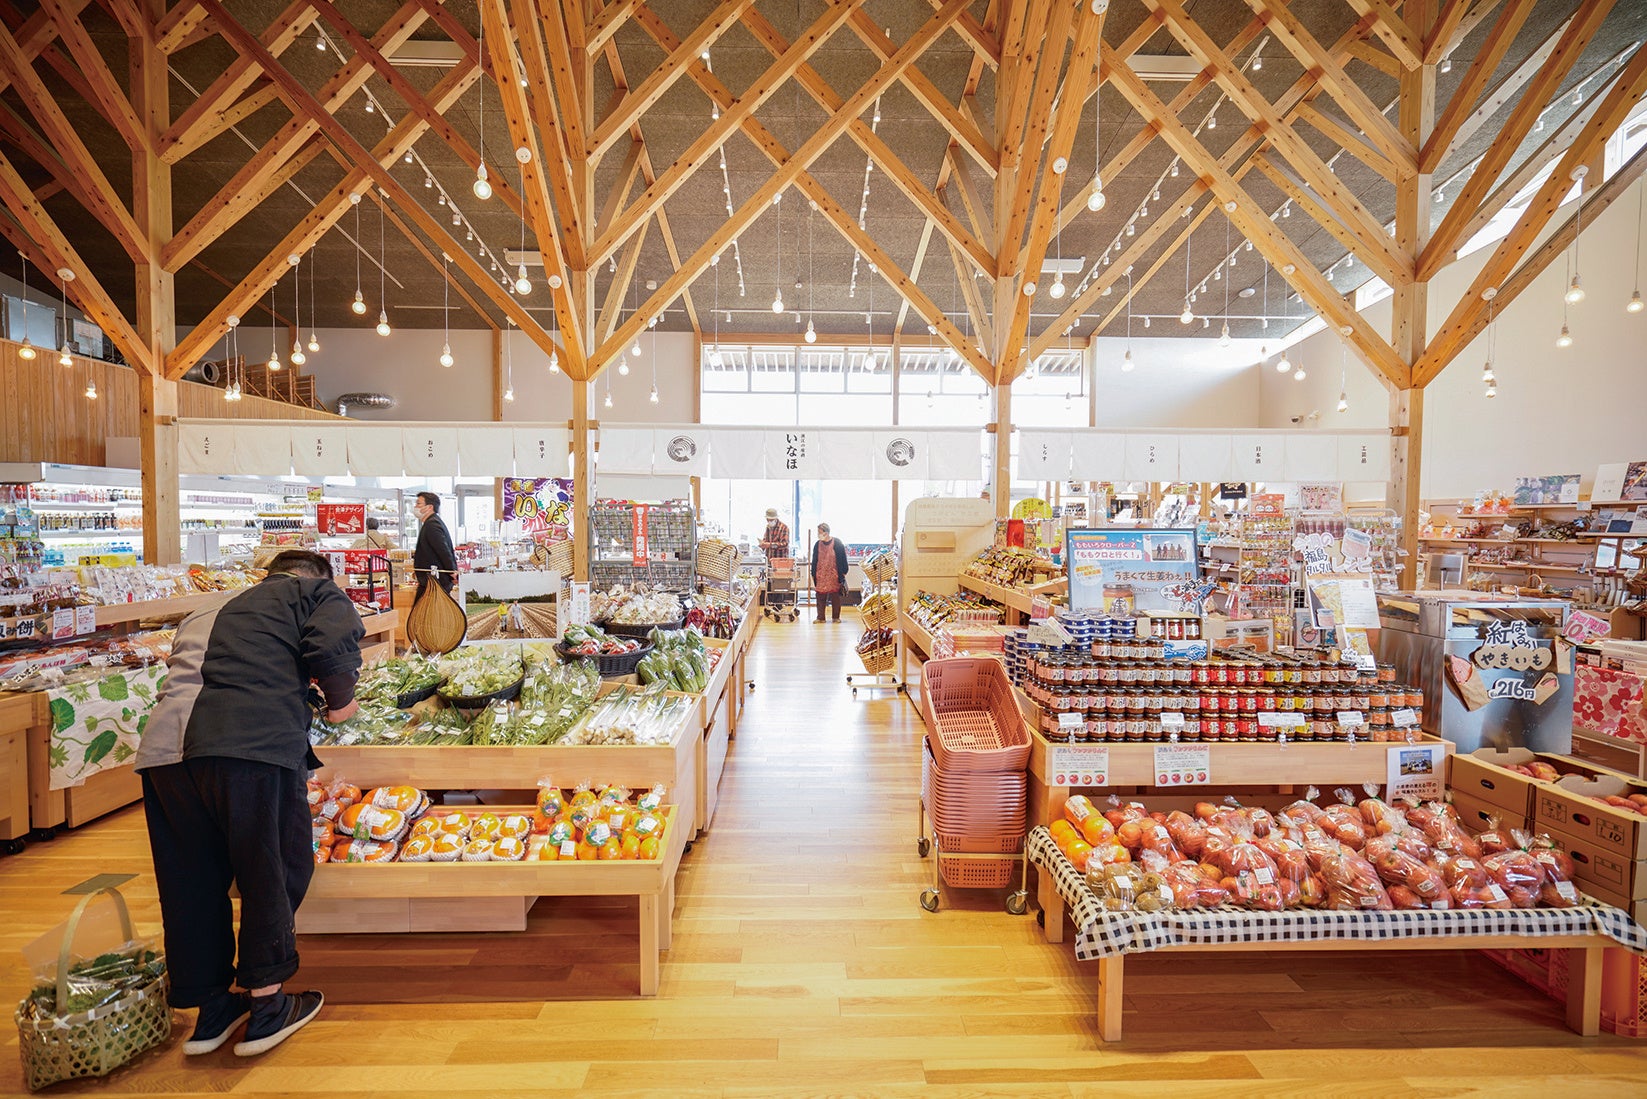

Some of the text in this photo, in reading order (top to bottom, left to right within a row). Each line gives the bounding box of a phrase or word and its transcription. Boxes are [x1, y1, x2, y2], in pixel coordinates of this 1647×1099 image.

[786, 433, 798, 470] いなほ
[1075, 541, 1137, 549] ももいろクローバーZ
[1304, 547, 1328, 563] 福島
[1306, 562, 1332, 575] タルタル
[1481, 652, 1543, 666] やきいも
[1497, 681, 1535, 699] 216円
